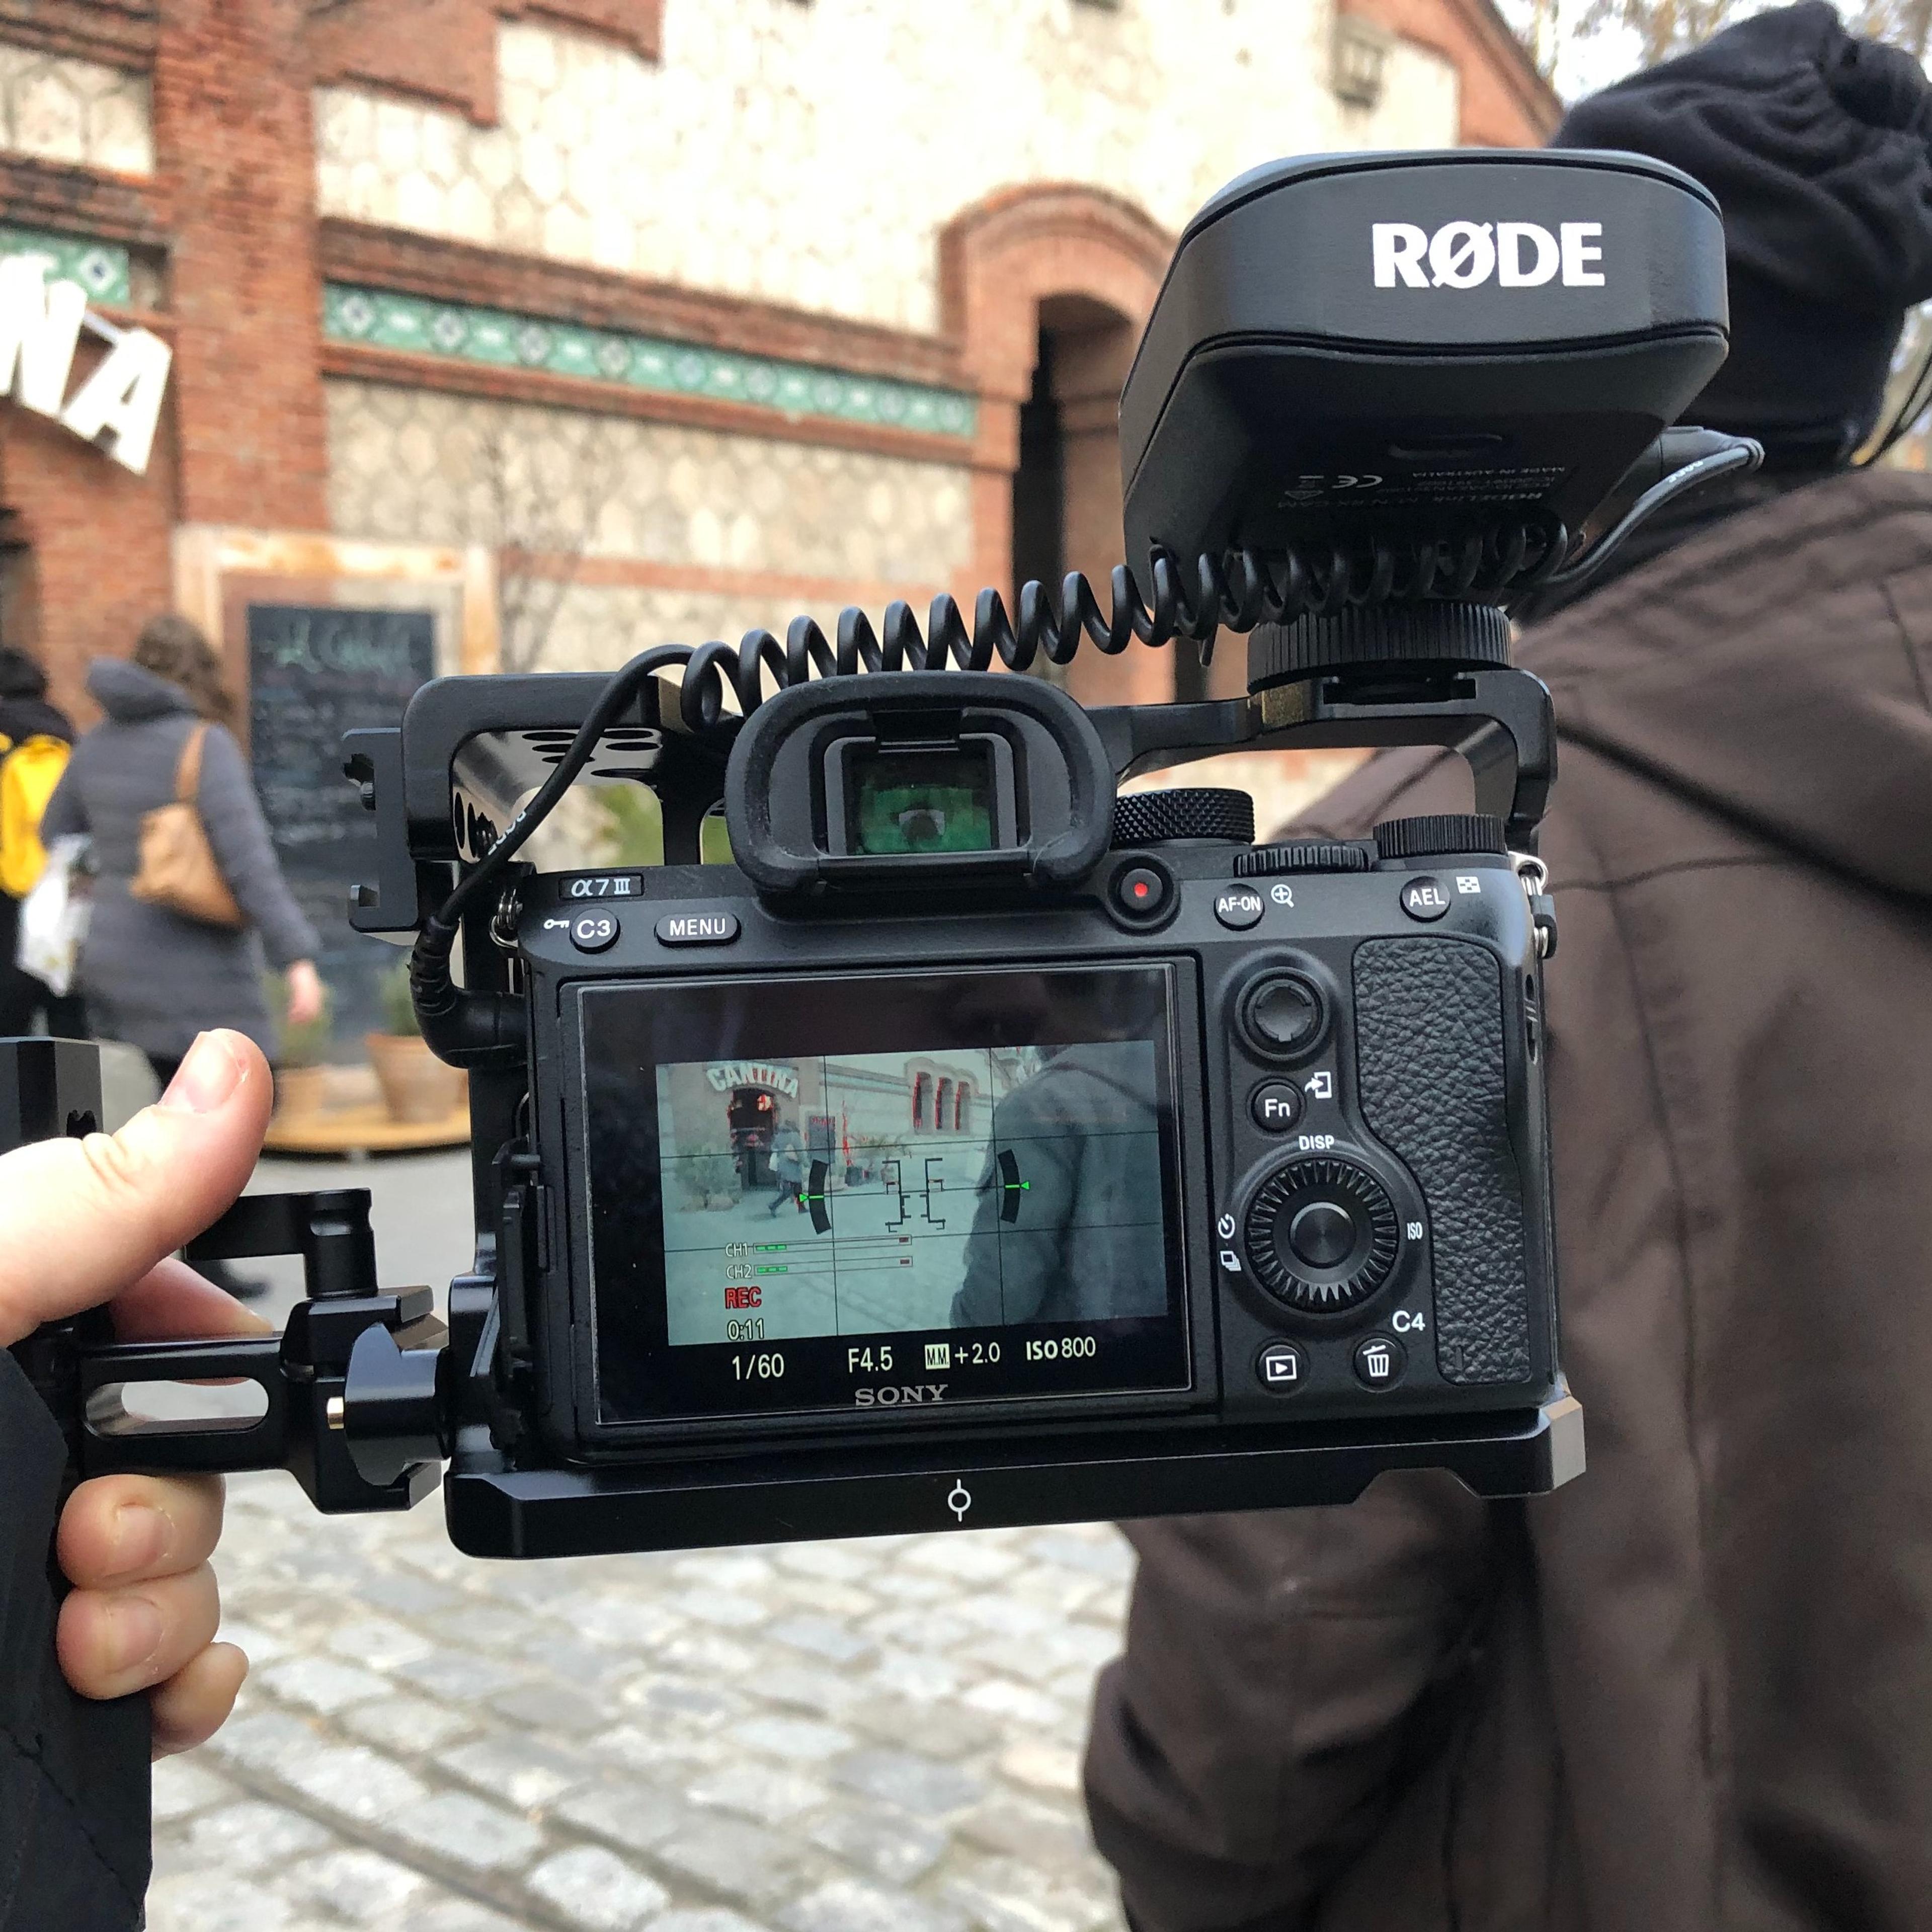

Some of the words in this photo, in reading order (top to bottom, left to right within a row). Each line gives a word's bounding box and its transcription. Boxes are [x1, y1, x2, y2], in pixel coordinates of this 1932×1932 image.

[1372, 220, 1605, 288] RØDE
[1217, 896, 1262, 913] AF-ON
[1409, 888, 1446, 906] AEL
[576, 920, 610, 939] C3
[669, 918, 726, 936] MENU
[1264, 1098, 1291, 1117] Fn
[1298, 1135, 1335, 1151] DISP
[1407, 1222, 1423, 1240] ISO
[725, 1242, 749, 1258] CH1
[726, 1263, 752, 1279] CH2
[725, 1286, 762, 1309] REC
[727, 1318, 765, 1341] 0:11
[1392, 1312, 1426, 1332] C4
[732, 1352, 784, 1380] 1/60
[848, 1346, 893, 1374] F4.5
[855, 1384, 948, 1406] SONY
